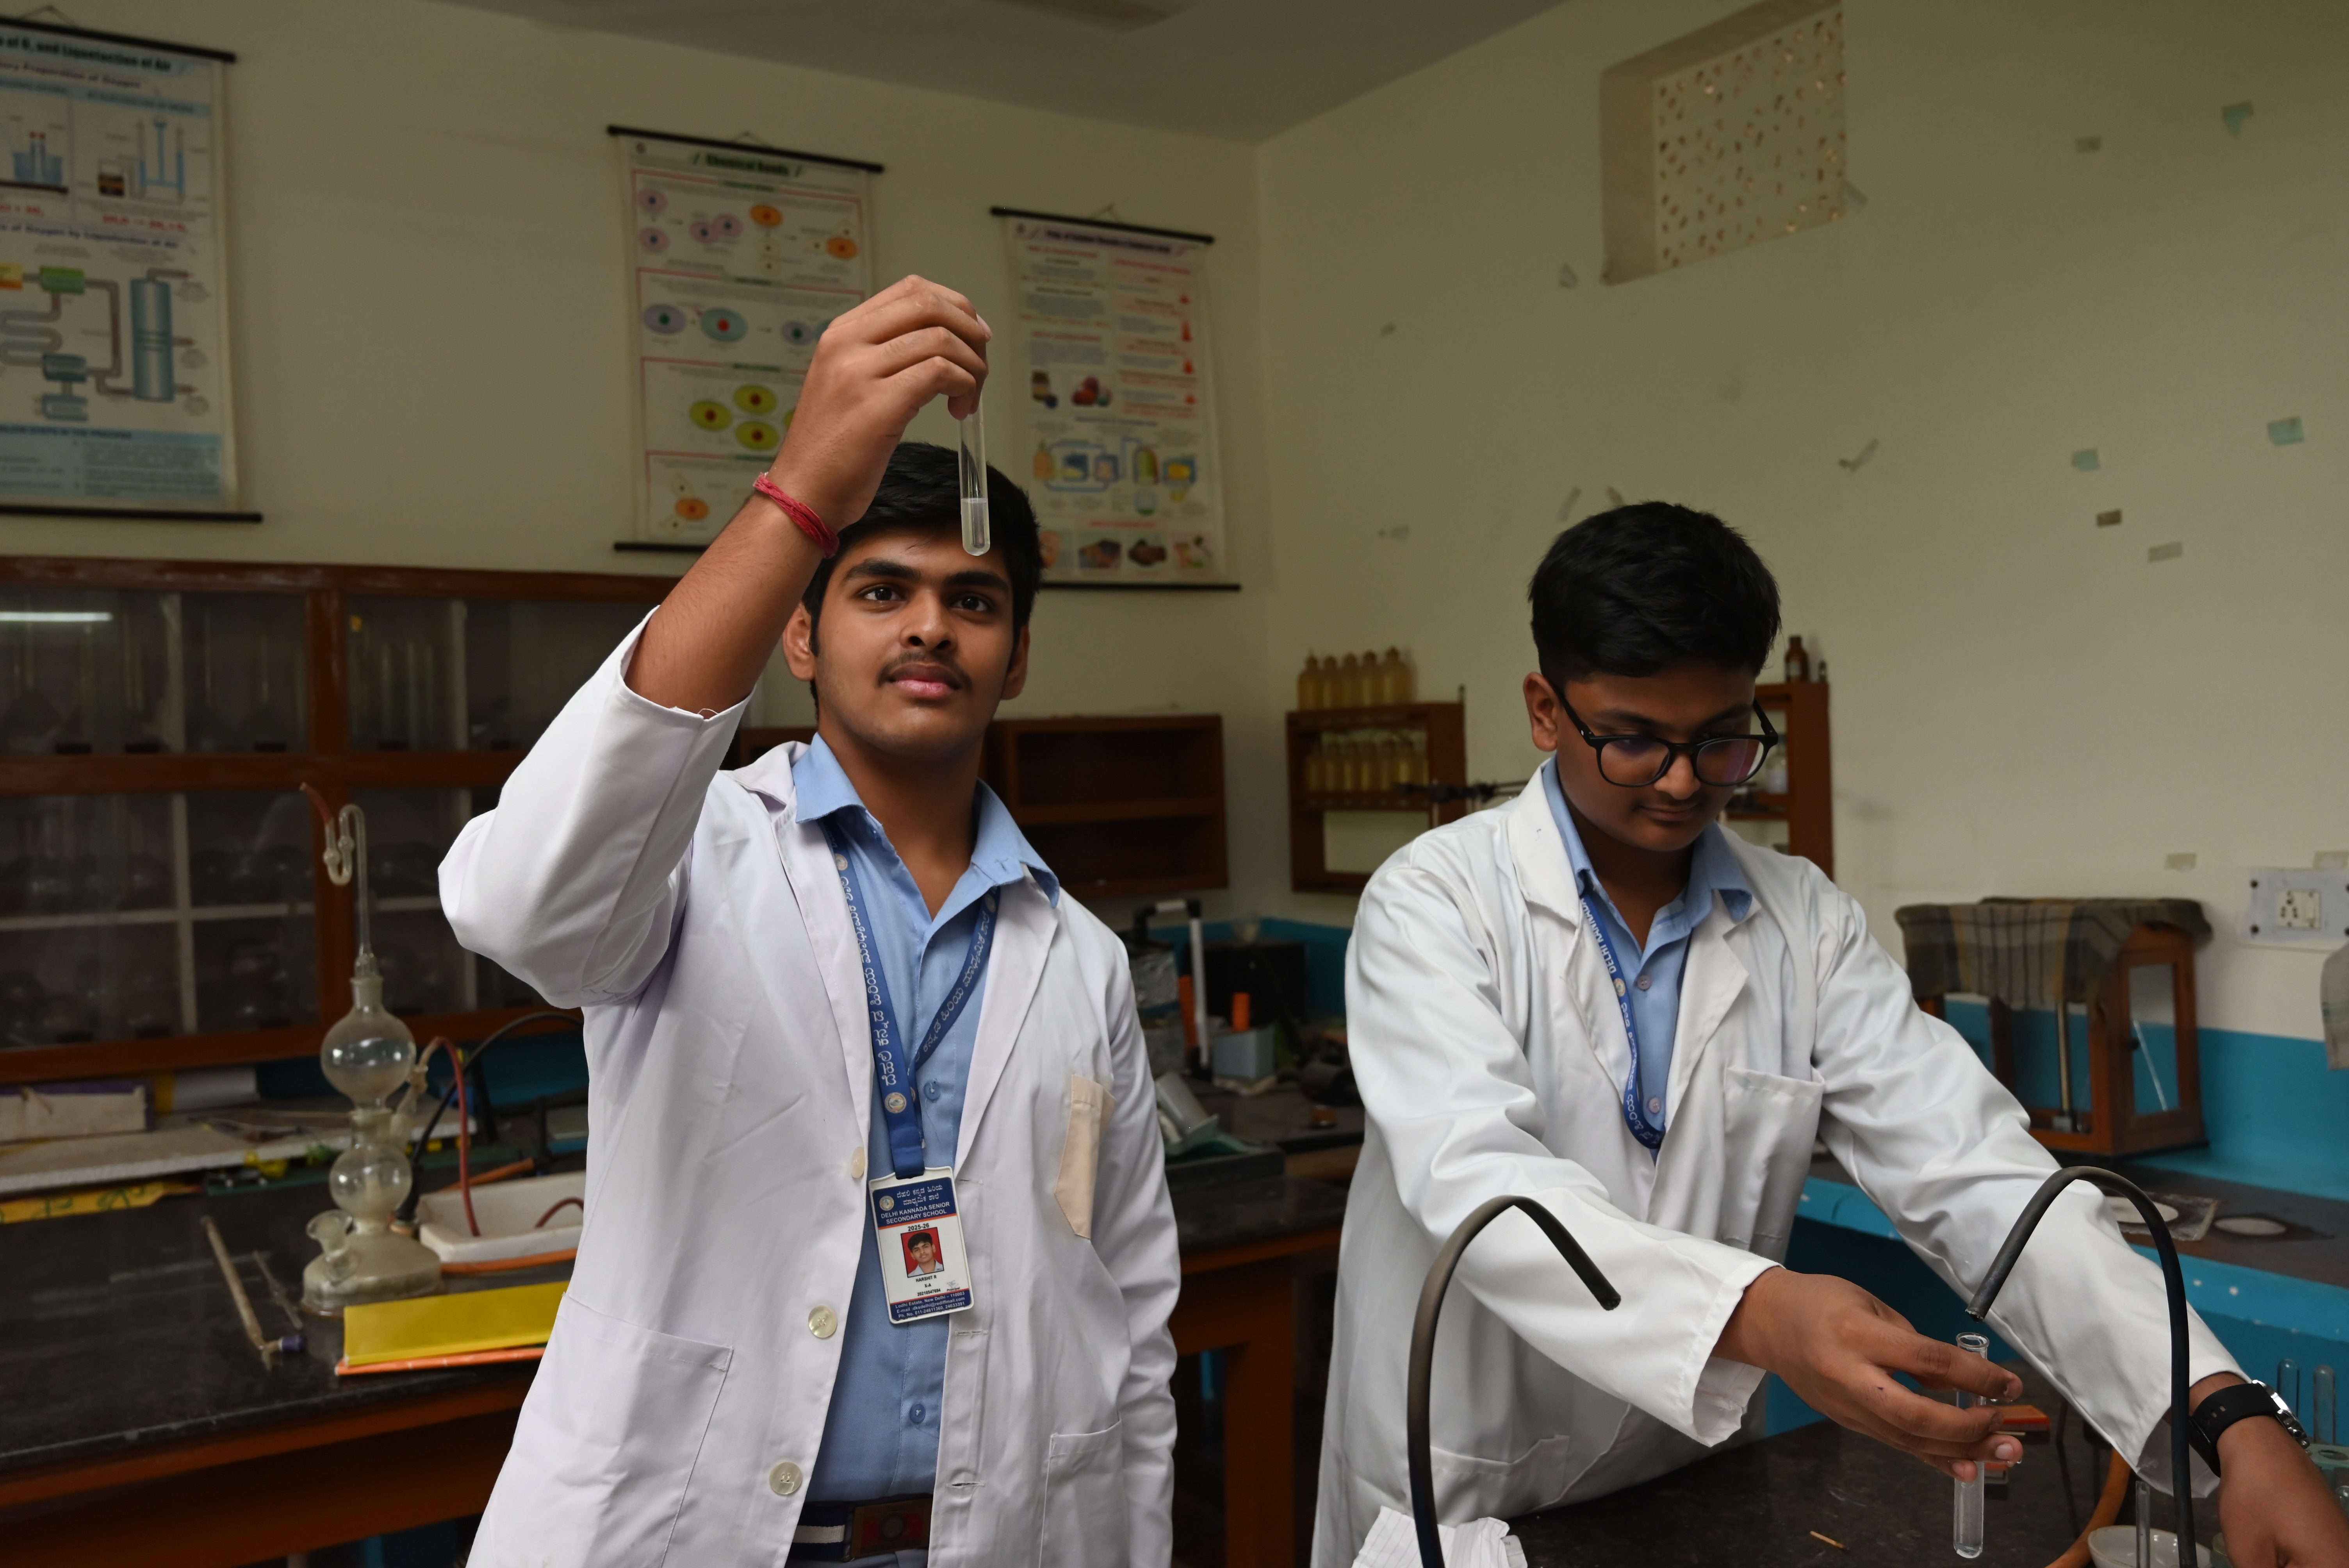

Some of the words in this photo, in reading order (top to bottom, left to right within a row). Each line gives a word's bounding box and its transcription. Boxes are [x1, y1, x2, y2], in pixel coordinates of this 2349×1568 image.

[1599, 944, 1616, 975] DELHI
[899, 1206, 928, 1215] KANNADA
[929, 1201, 950, 1210] SENIOR
[886, 1213, 921, 1224] SECONDARY
[923, 1209, 947, 1217] SCHOOL
[908, 1223, 929, 1231] 2025-26
